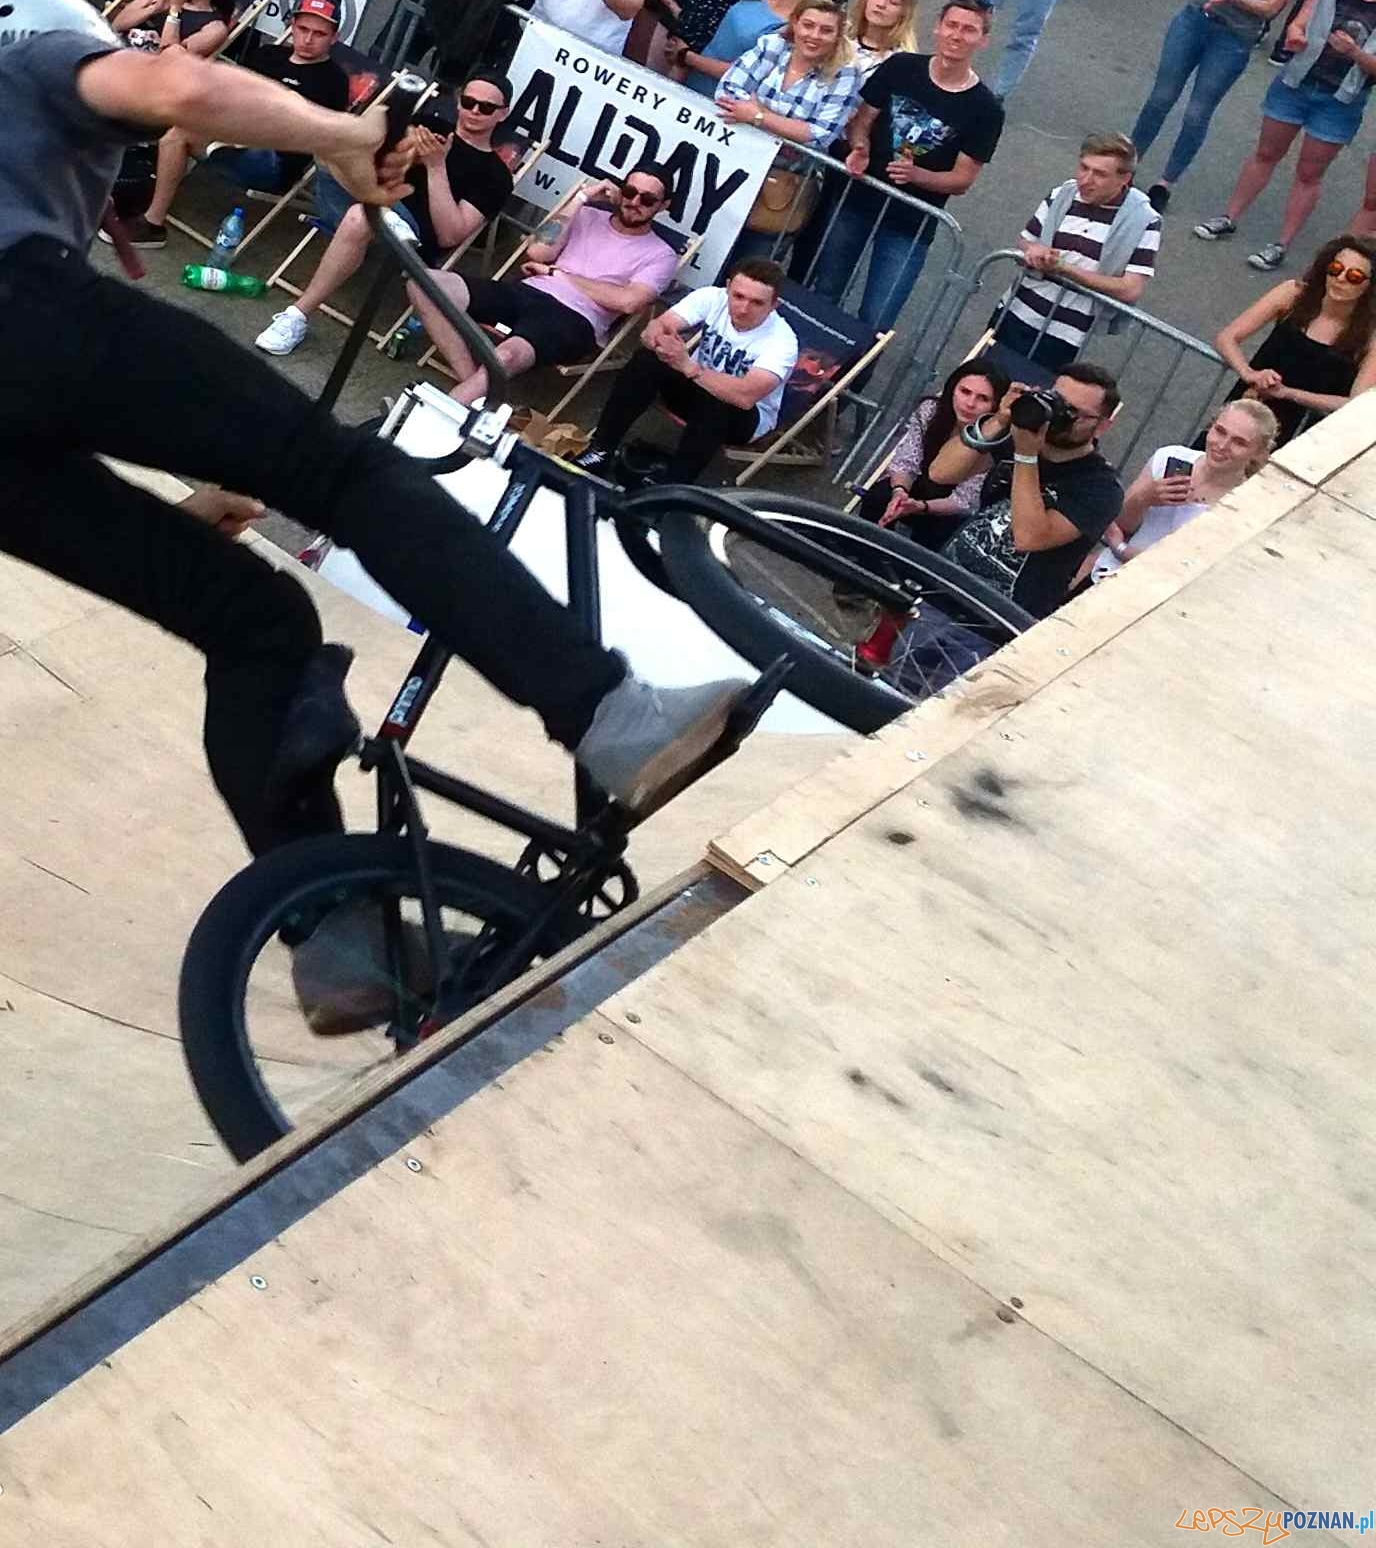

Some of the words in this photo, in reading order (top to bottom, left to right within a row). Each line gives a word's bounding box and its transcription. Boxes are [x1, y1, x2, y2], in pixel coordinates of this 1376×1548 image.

[498, 68, 750, 235] ALLDAY
[554, 47, 667, 110] ROWERY
[675, 106, 736, 146] BMX
